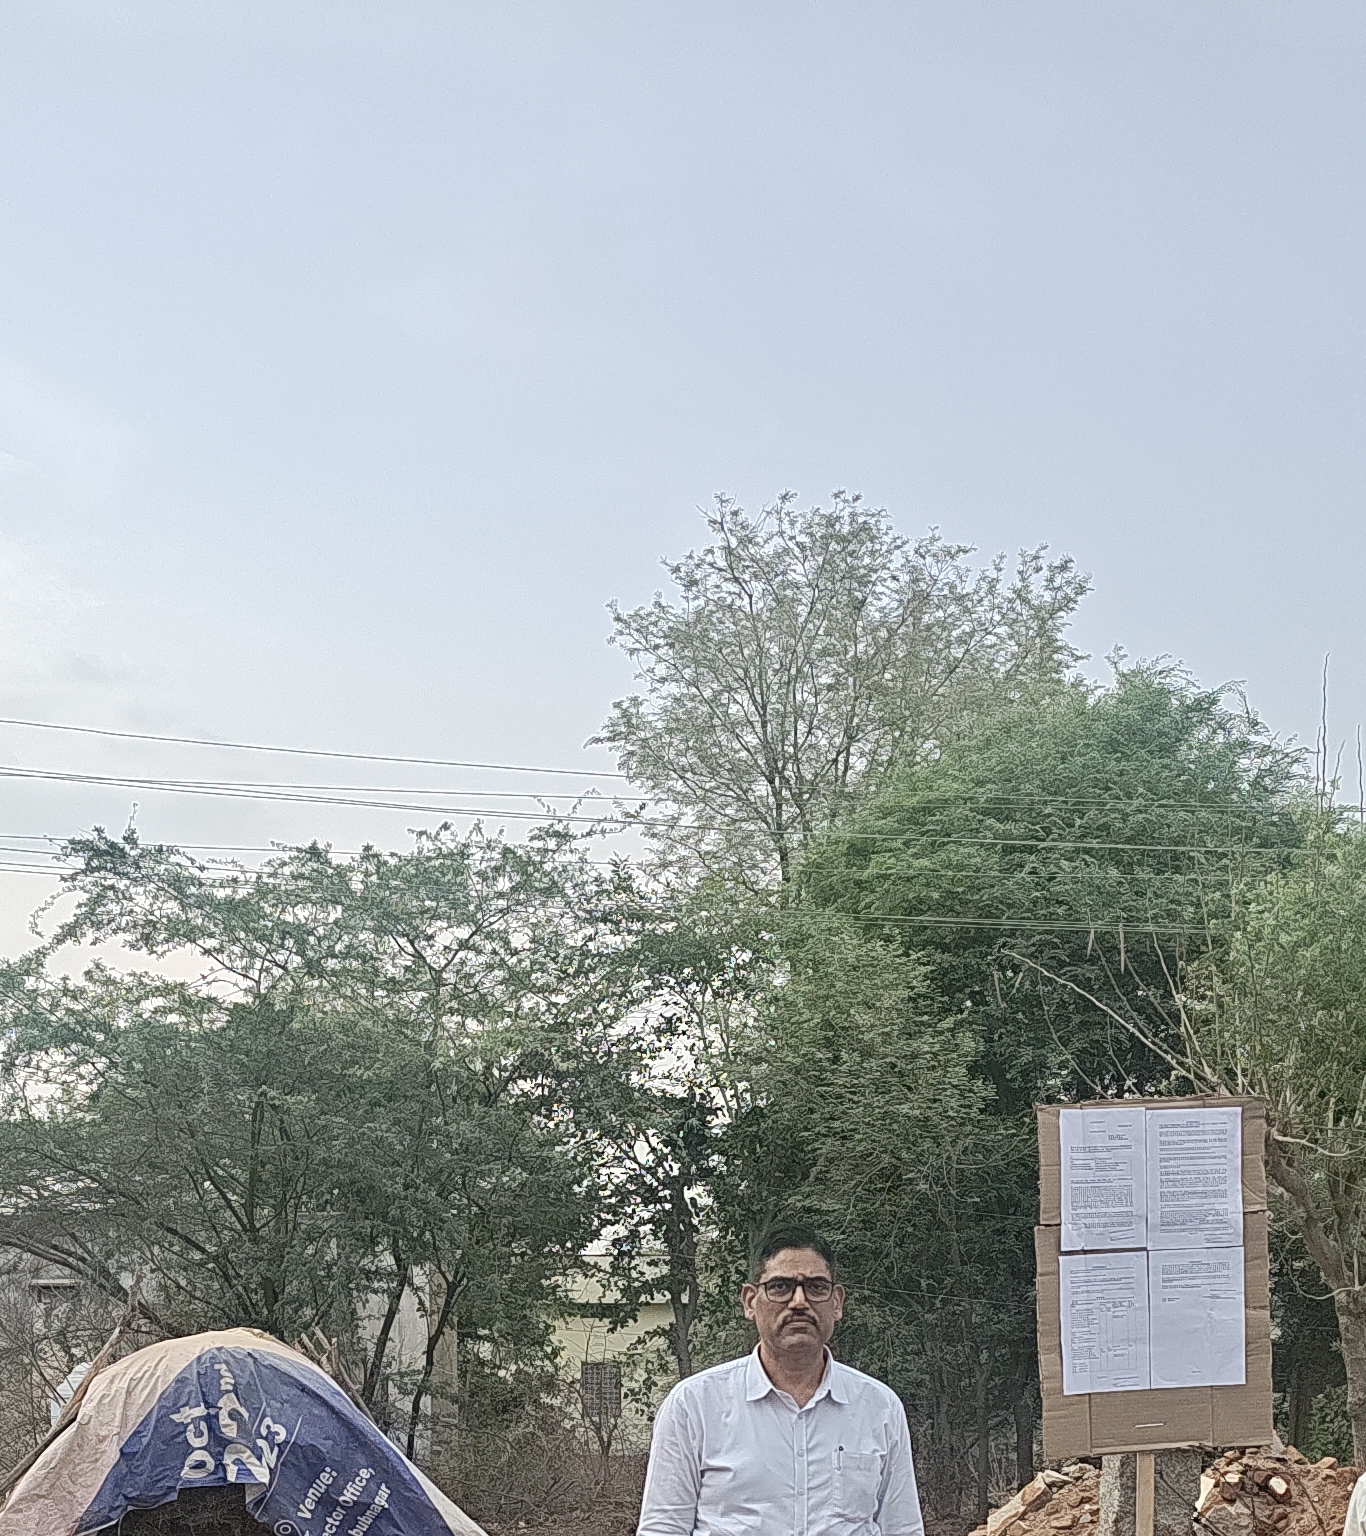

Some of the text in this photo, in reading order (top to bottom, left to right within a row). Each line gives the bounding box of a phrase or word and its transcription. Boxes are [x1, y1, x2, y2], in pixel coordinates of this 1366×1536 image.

[169, 1402, 215, 1479] Oct
[296, 1466, 338, 1519] Venue:
[338, 1467, 376, 1507] Office,
